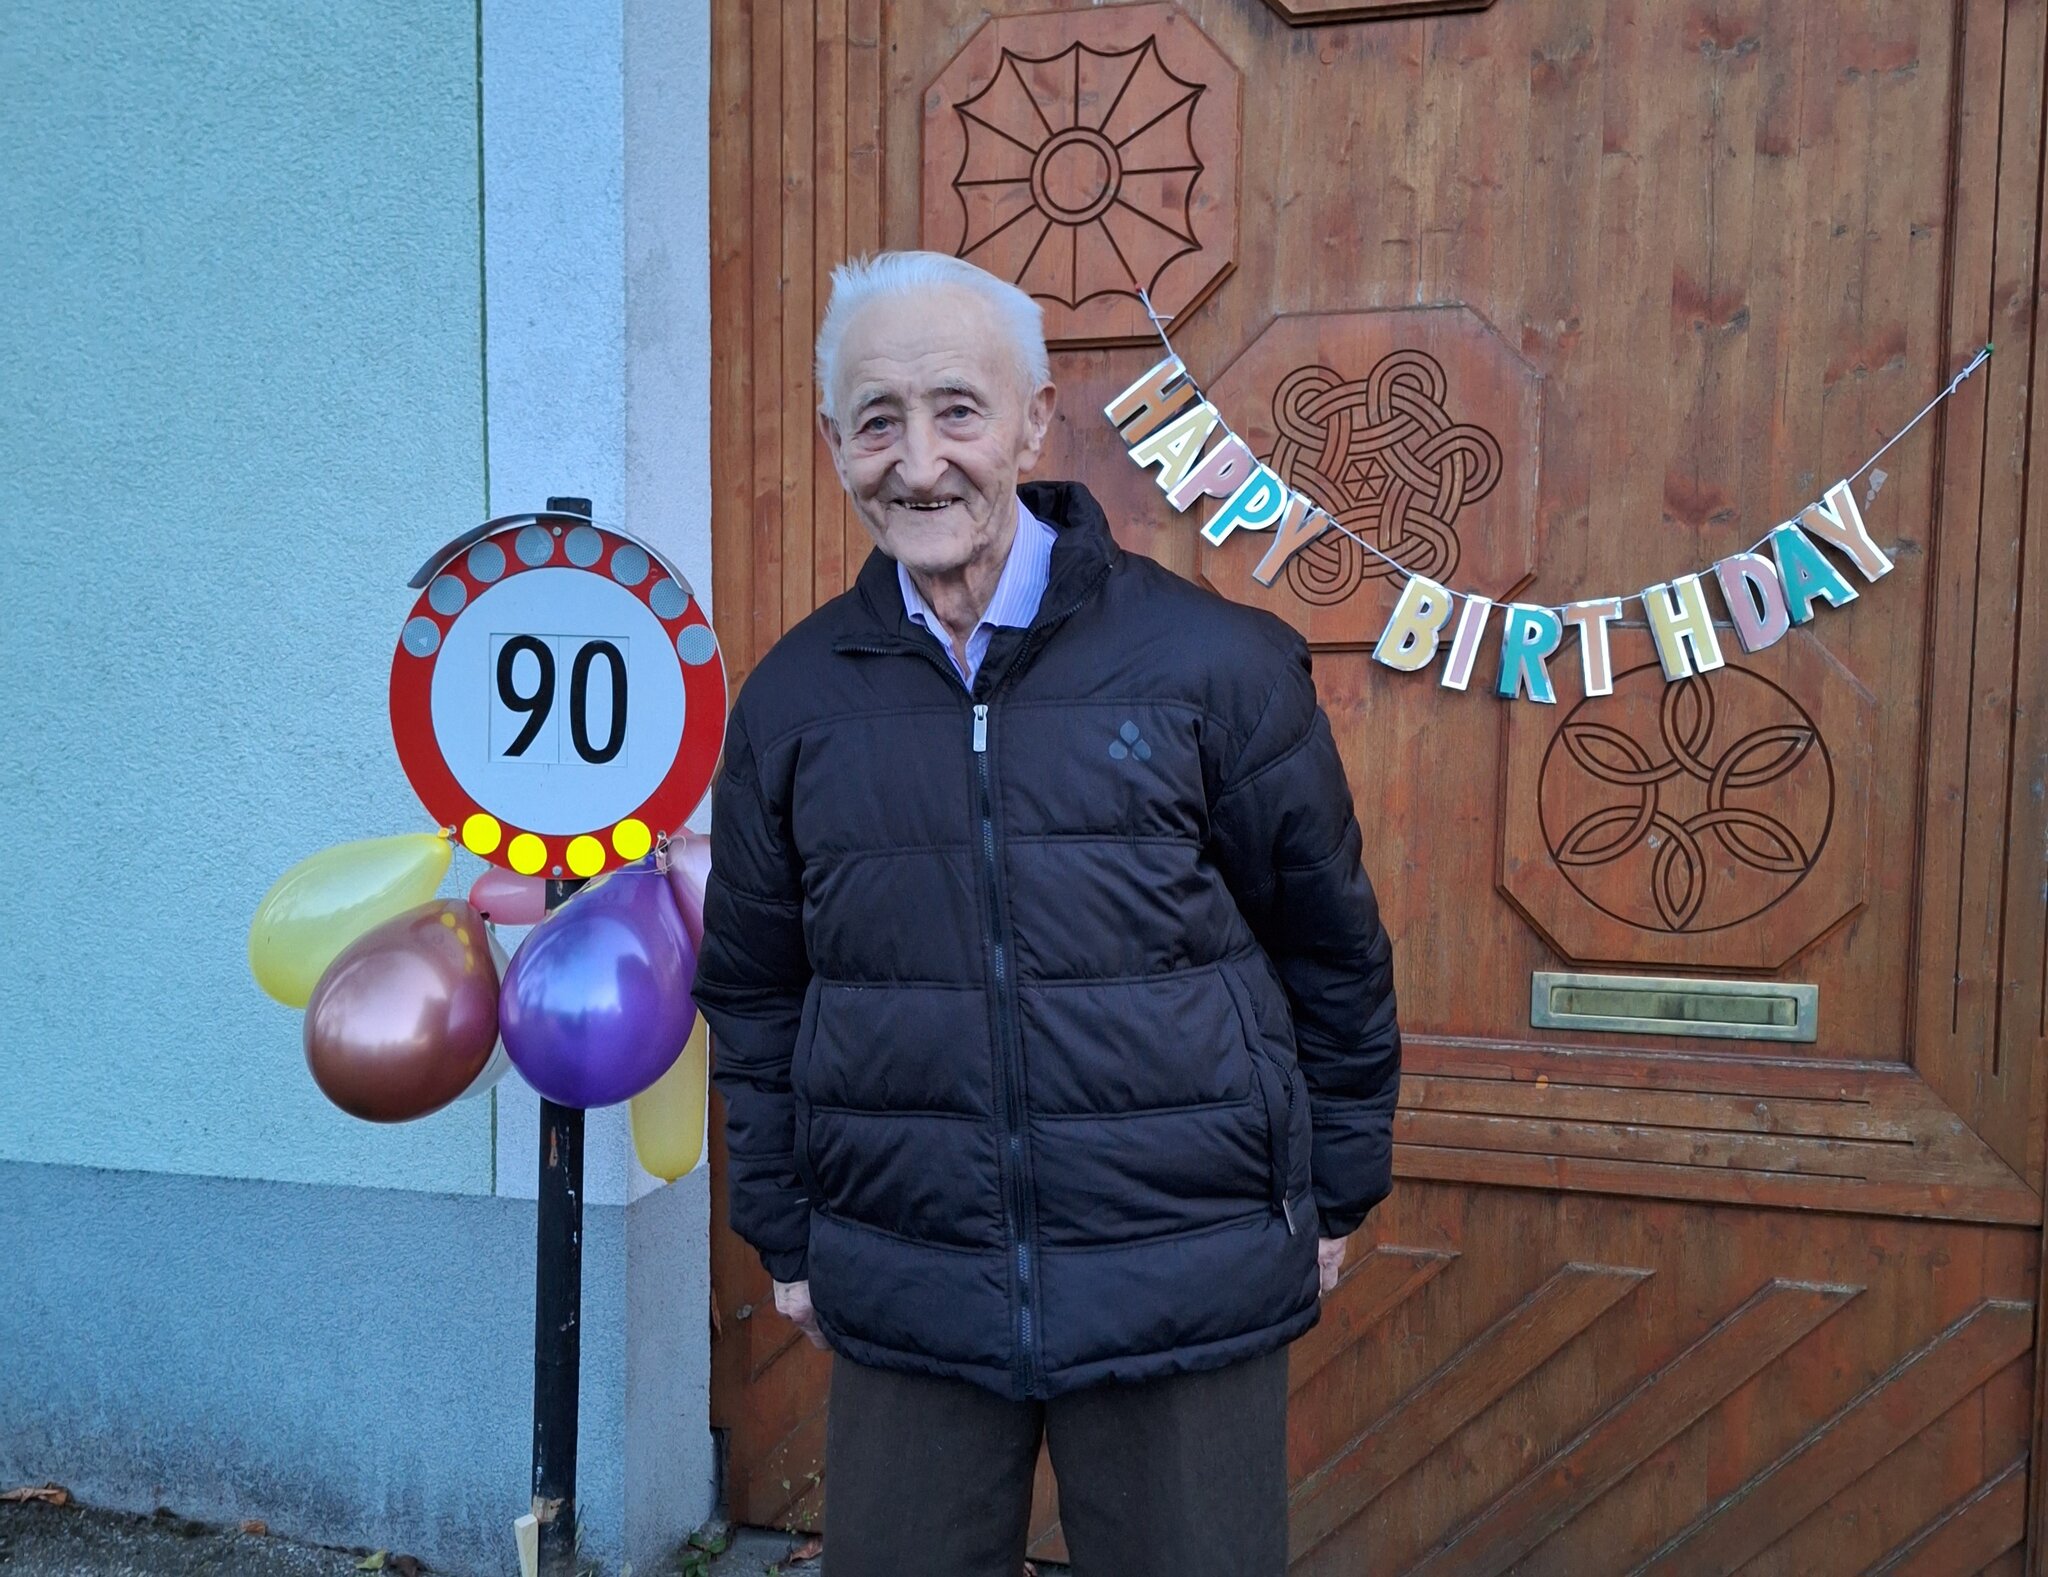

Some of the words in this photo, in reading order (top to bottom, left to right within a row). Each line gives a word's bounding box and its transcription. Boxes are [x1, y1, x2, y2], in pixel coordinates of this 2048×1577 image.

[1104, 354, 1331, 588] HAPPY
[1372, 479, 1894, 704] BIRTHDAY
[496, 635, 628, 764] 90
